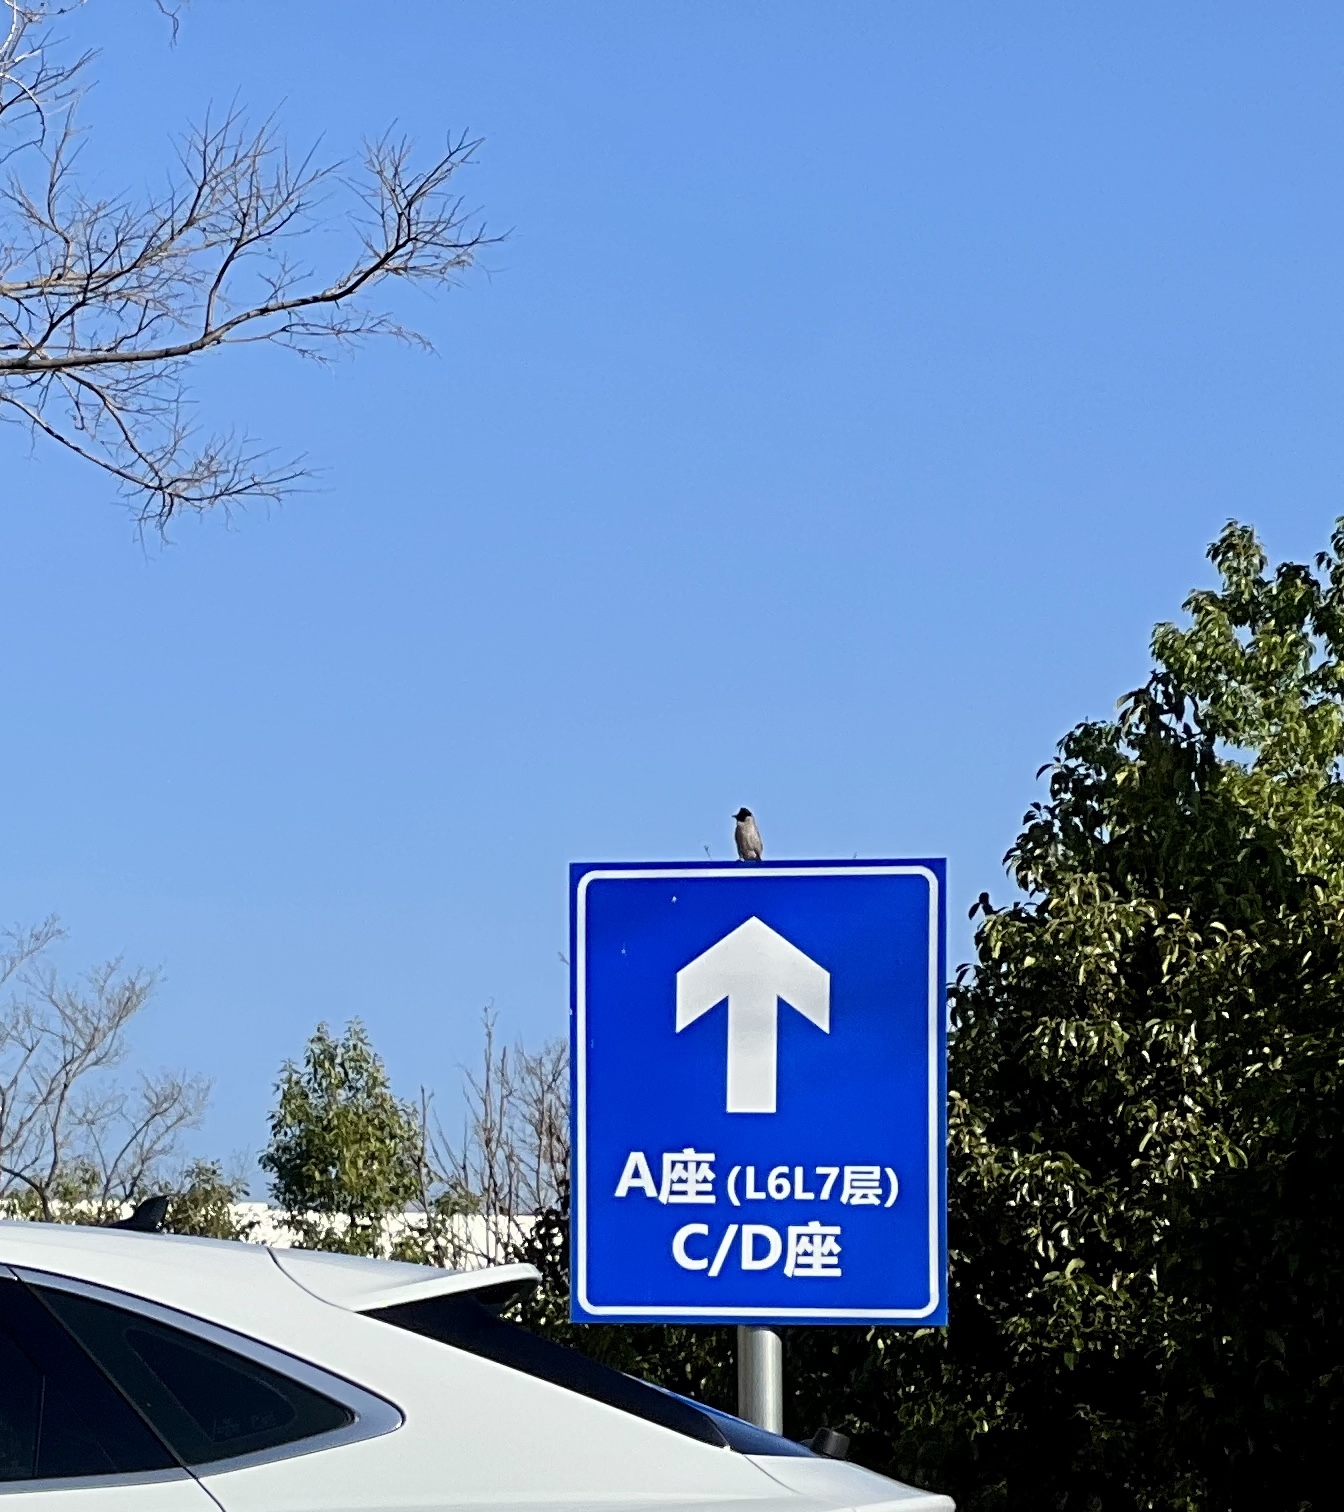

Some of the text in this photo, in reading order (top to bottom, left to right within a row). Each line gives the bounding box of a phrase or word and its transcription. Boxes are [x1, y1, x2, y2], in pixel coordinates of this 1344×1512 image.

[614, 1147, 900, 1208] A座 (L6L7层)
[671, 1220, 842, 1278] C/D座
